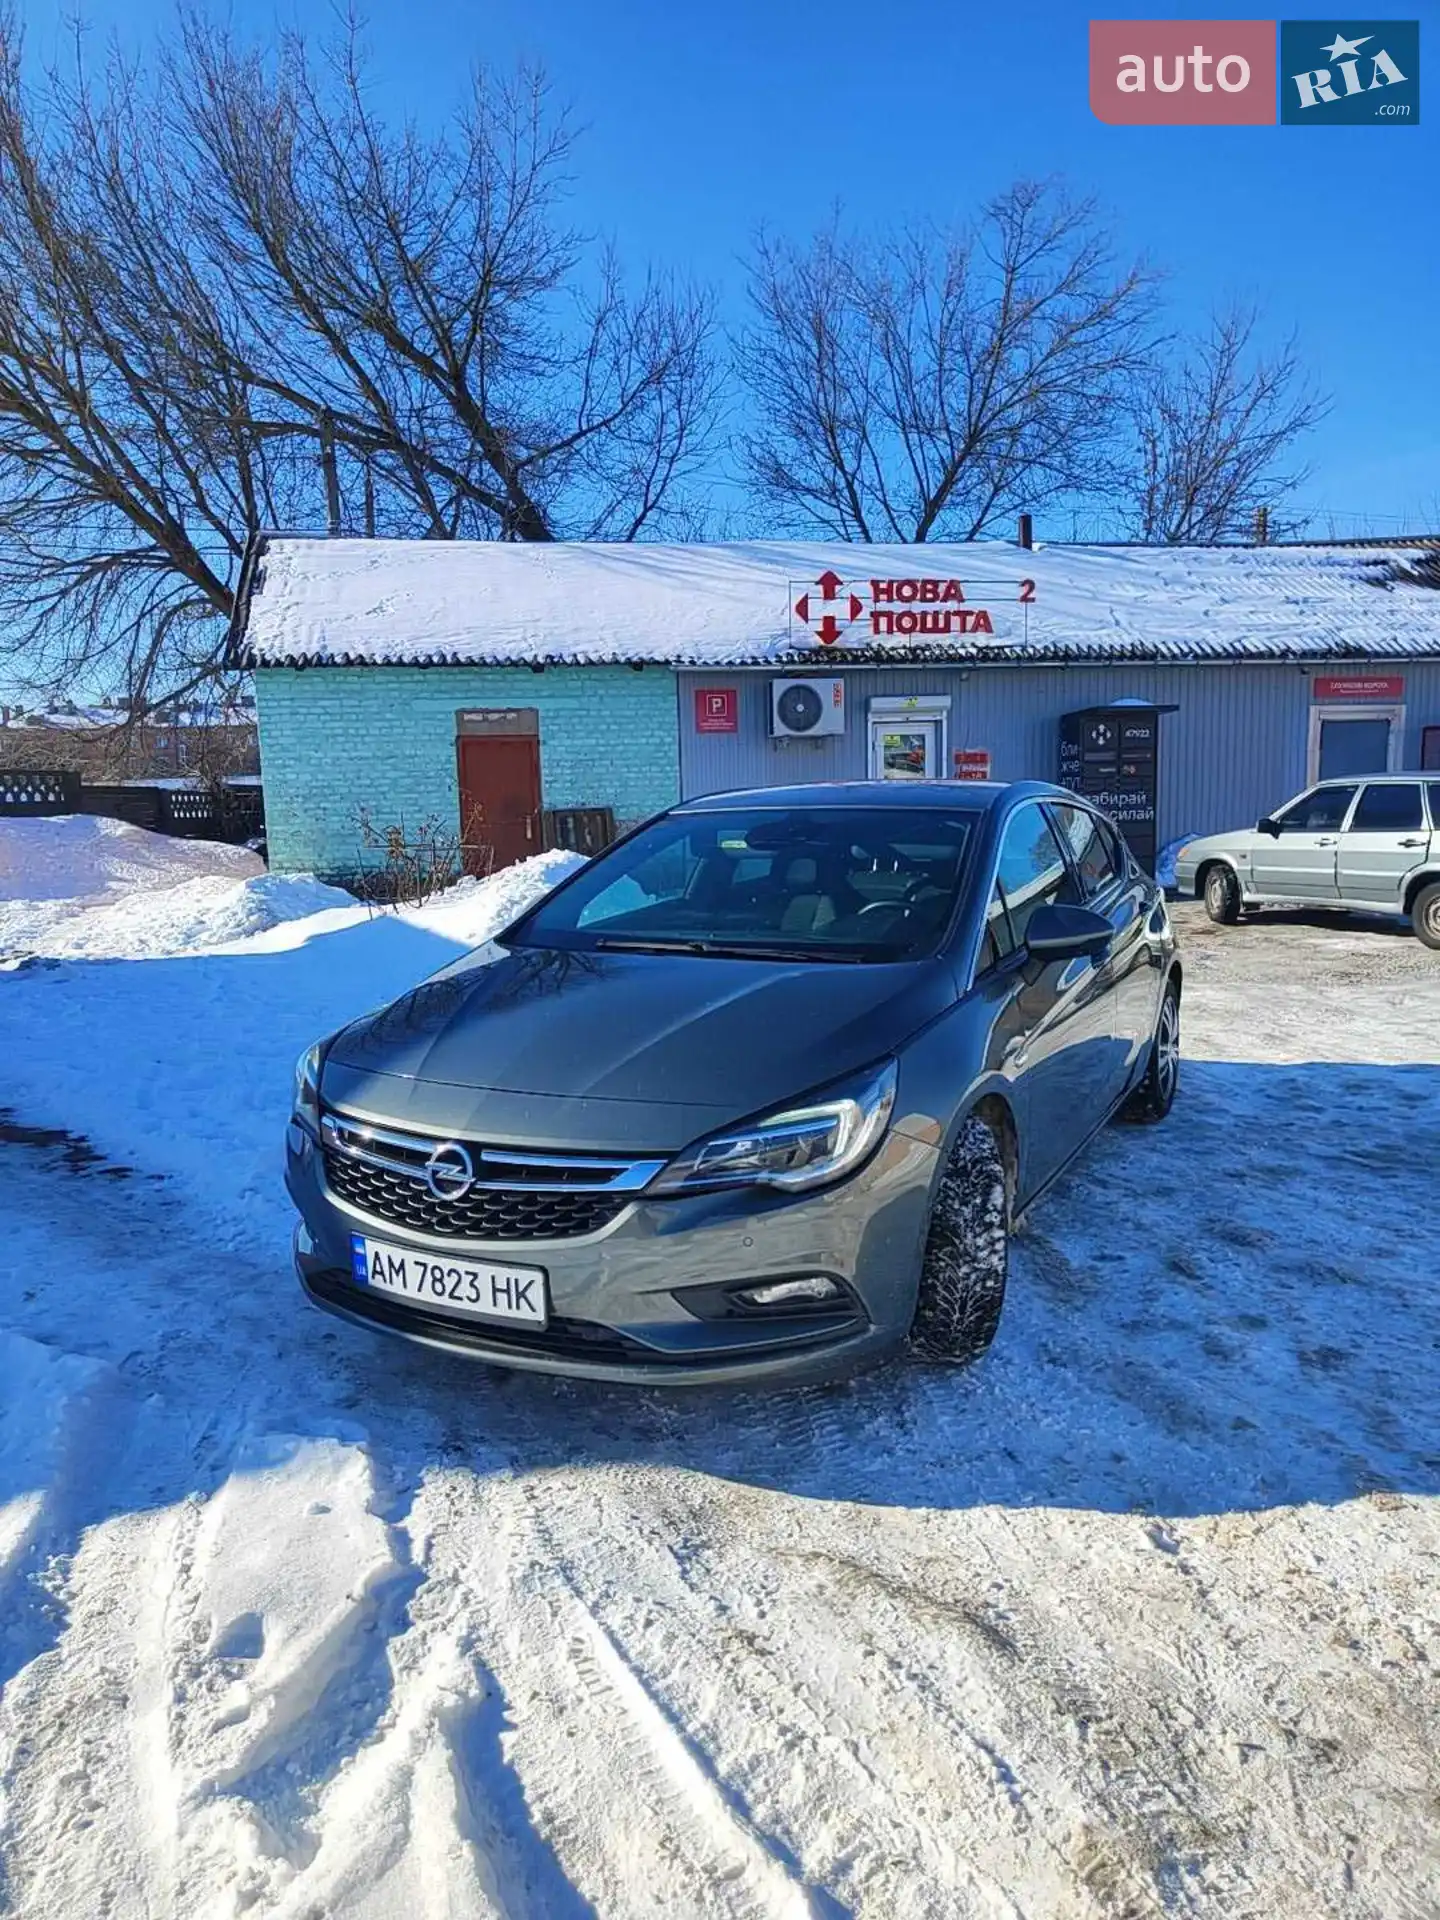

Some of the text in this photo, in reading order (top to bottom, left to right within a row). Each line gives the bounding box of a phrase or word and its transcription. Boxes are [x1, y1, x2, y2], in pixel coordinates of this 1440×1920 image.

[869, 578, 1036, 603] НОВА 2
[869, 610, 994, 634] ПОШТА
[371, 1250, 537, 1313] AM 7823 HK
